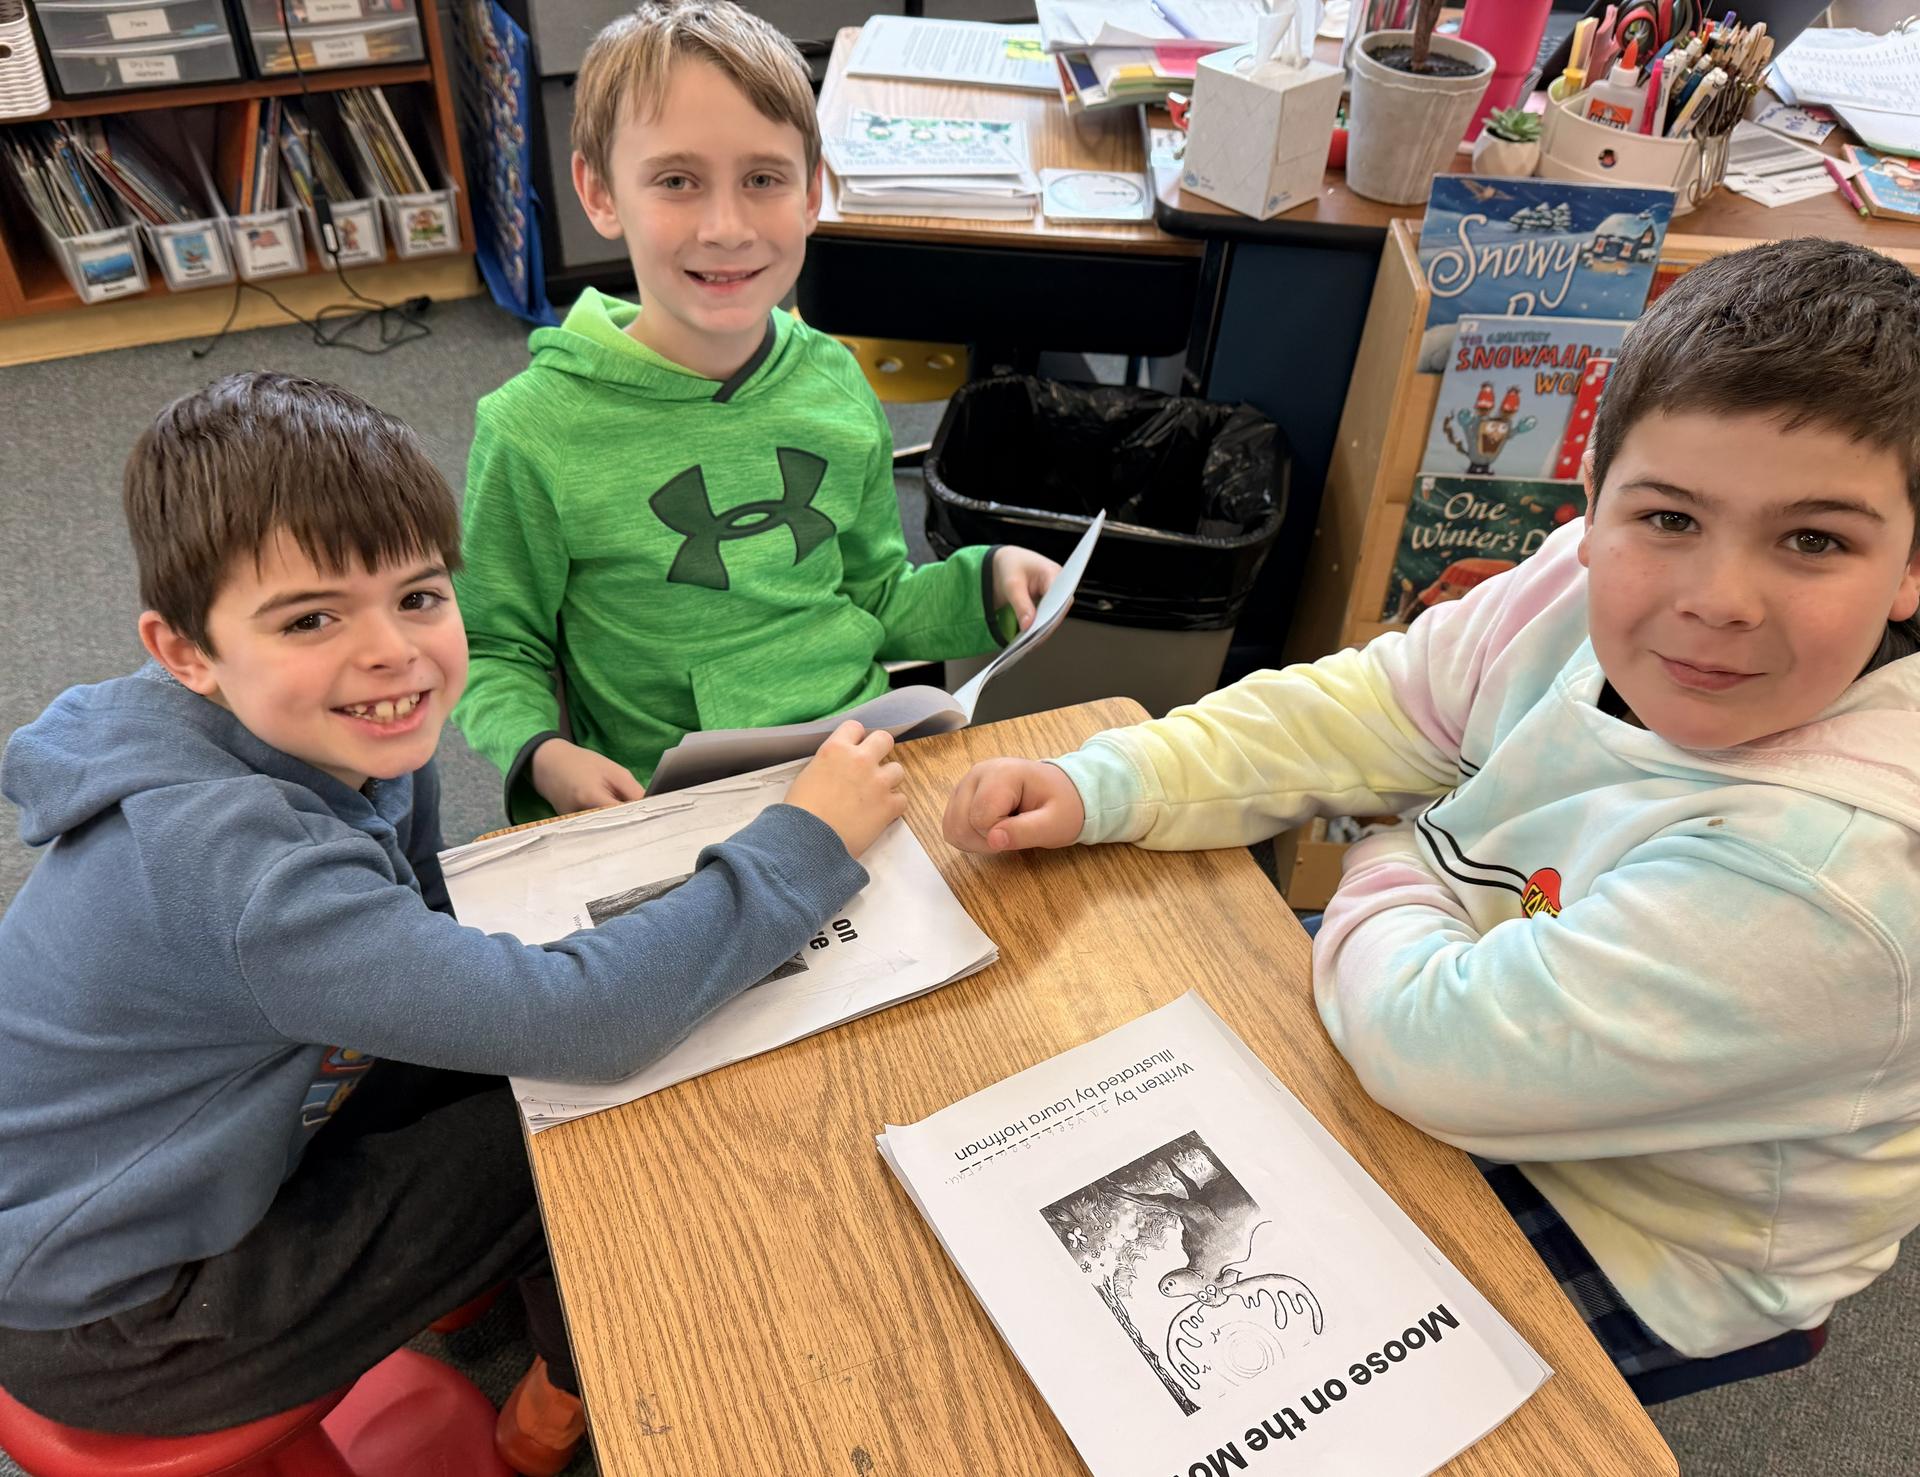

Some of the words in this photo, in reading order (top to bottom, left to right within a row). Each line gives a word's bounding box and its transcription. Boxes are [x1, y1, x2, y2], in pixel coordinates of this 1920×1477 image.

[1428, 214, 1581, 309] Snowy
[1456, 344, 1600, 372] SNOWMAN
[1444, 492, 1508, 521] One
[1411, 521, 1519, 552] Winter's
[1099, 1048, 1176, 1094] Illustrated
[1138, 1061, 1195, 1096] Written
[1028, 1097, 1076, 1126] Laura
[1076, 1087, 1096, 1104] by
[1114, 1089, 1138, 1106] by
[954, 1119, 1029, 1162] Hoffman
[1348, 1303, 1461, 1386] Moose
[1300, 1378, 1348, 1415] on
[1244, 1406, 1308, 1452] the
[1173, 1441, 1249, 1477] Mo
